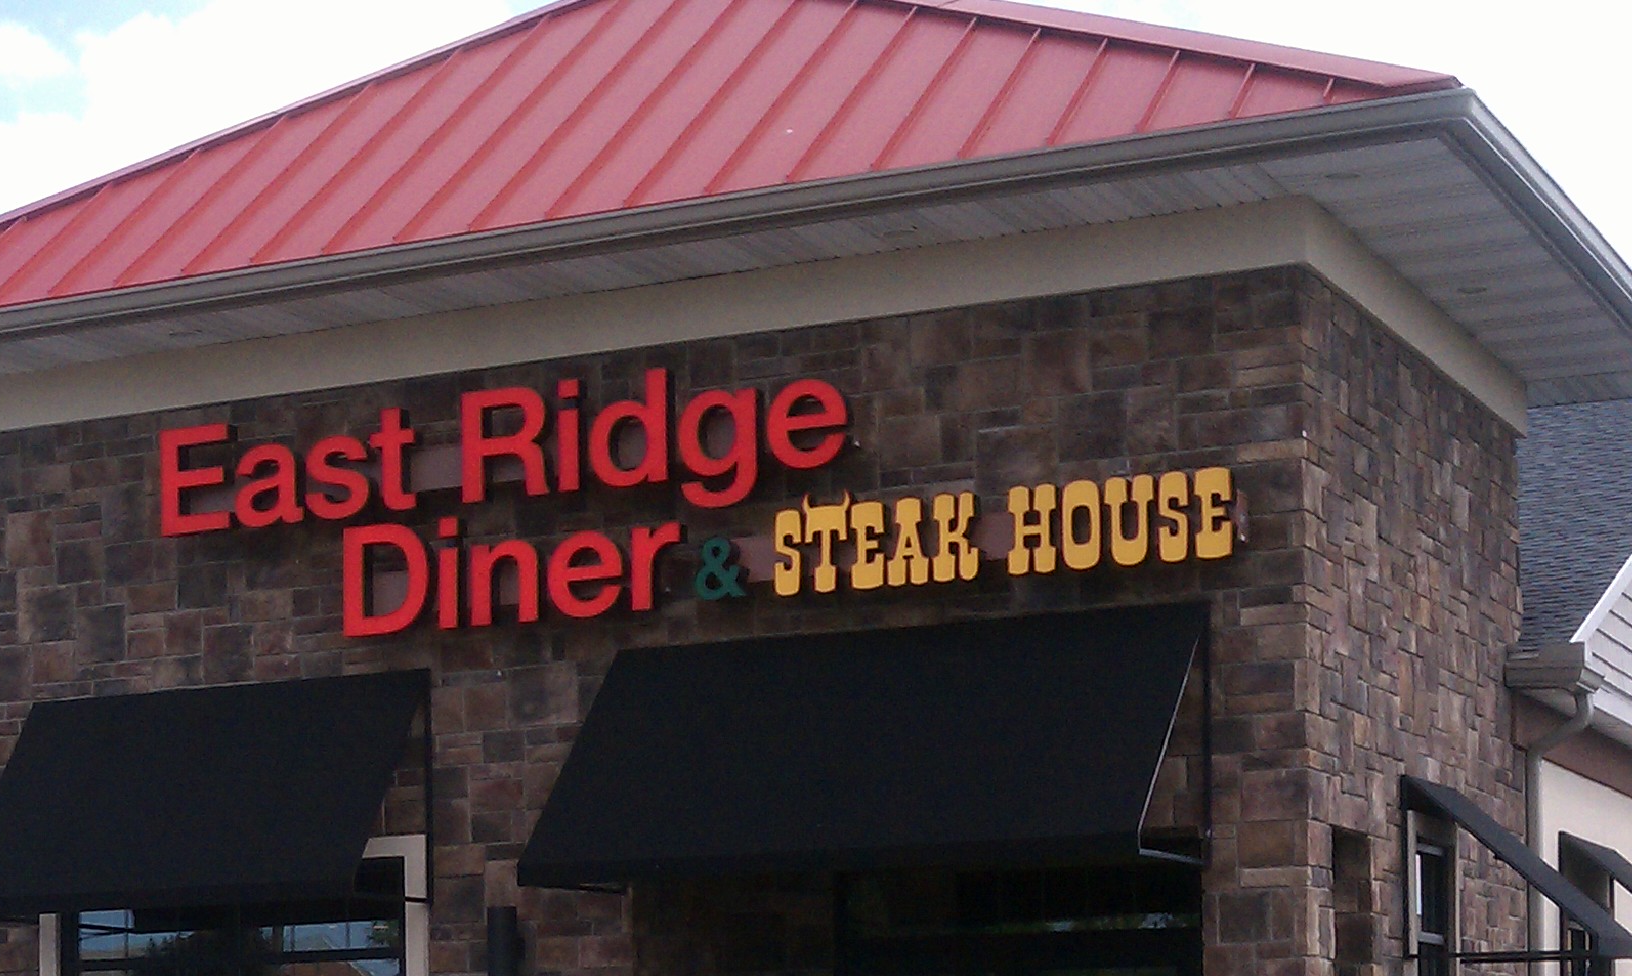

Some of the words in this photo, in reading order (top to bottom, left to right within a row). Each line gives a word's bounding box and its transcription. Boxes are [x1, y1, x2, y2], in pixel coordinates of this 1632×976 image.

[160, 407, 417, 536] East
[462, 368, 848, 508] Ridge
[343, 517, 682, 637] Diner
[695, 537, 745, 600] &
[773, 490, 980, 597] STEAK
[1007, 467, 1233, 576] HOUSE
